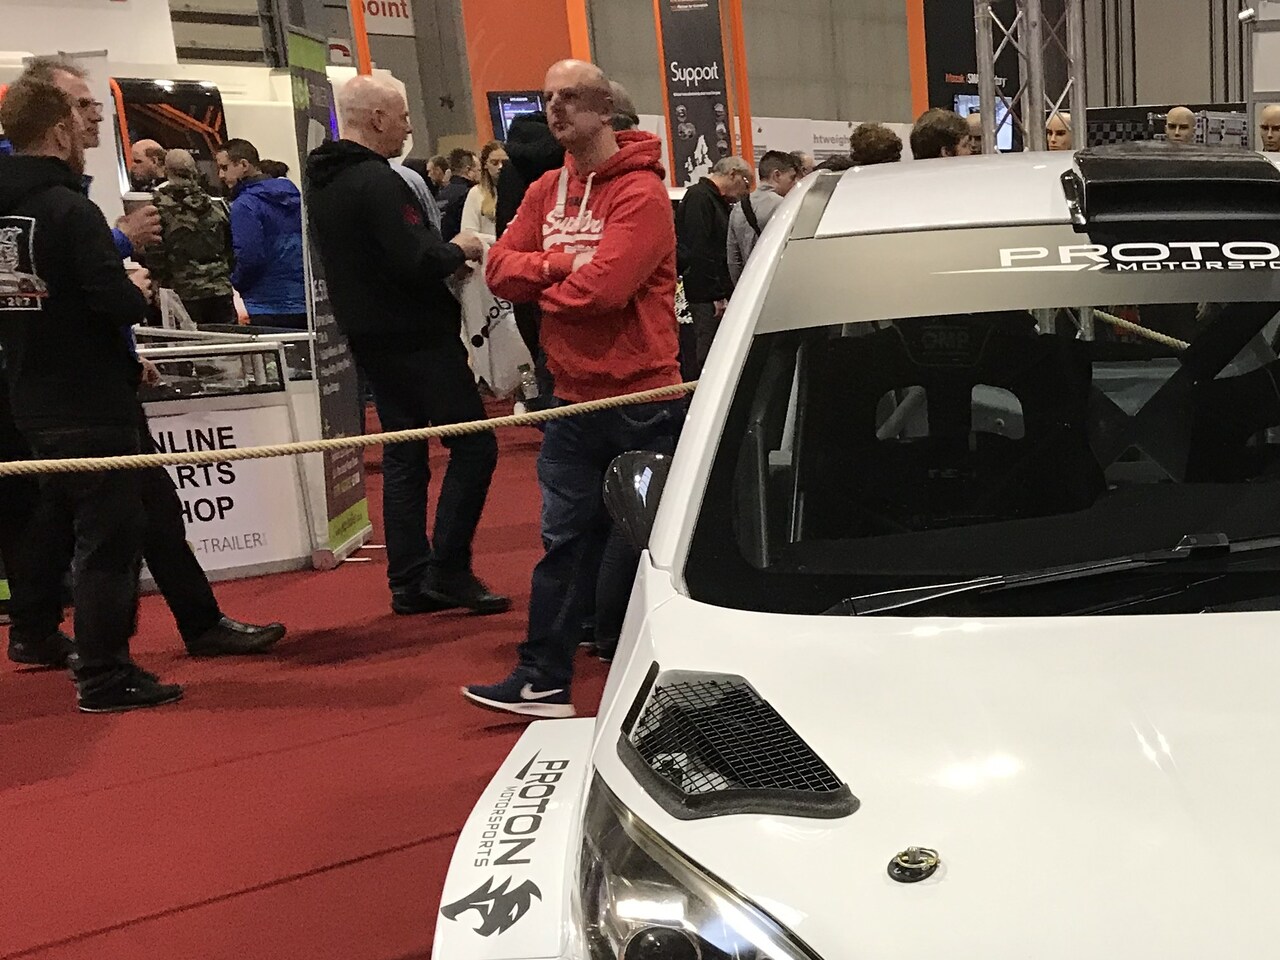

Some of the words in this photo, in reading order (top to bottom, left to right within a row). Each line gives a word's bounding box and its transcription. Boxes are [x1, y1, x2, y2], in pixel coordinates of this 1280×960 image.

[670, 61, 719, 87] Support
[150, 426, 236, 454] NLINE
[182, 496, 234, 525] HOP
[474, 786, 519, 868] MOTORSPORTS
[493, 759, 571, 866] PROTON
